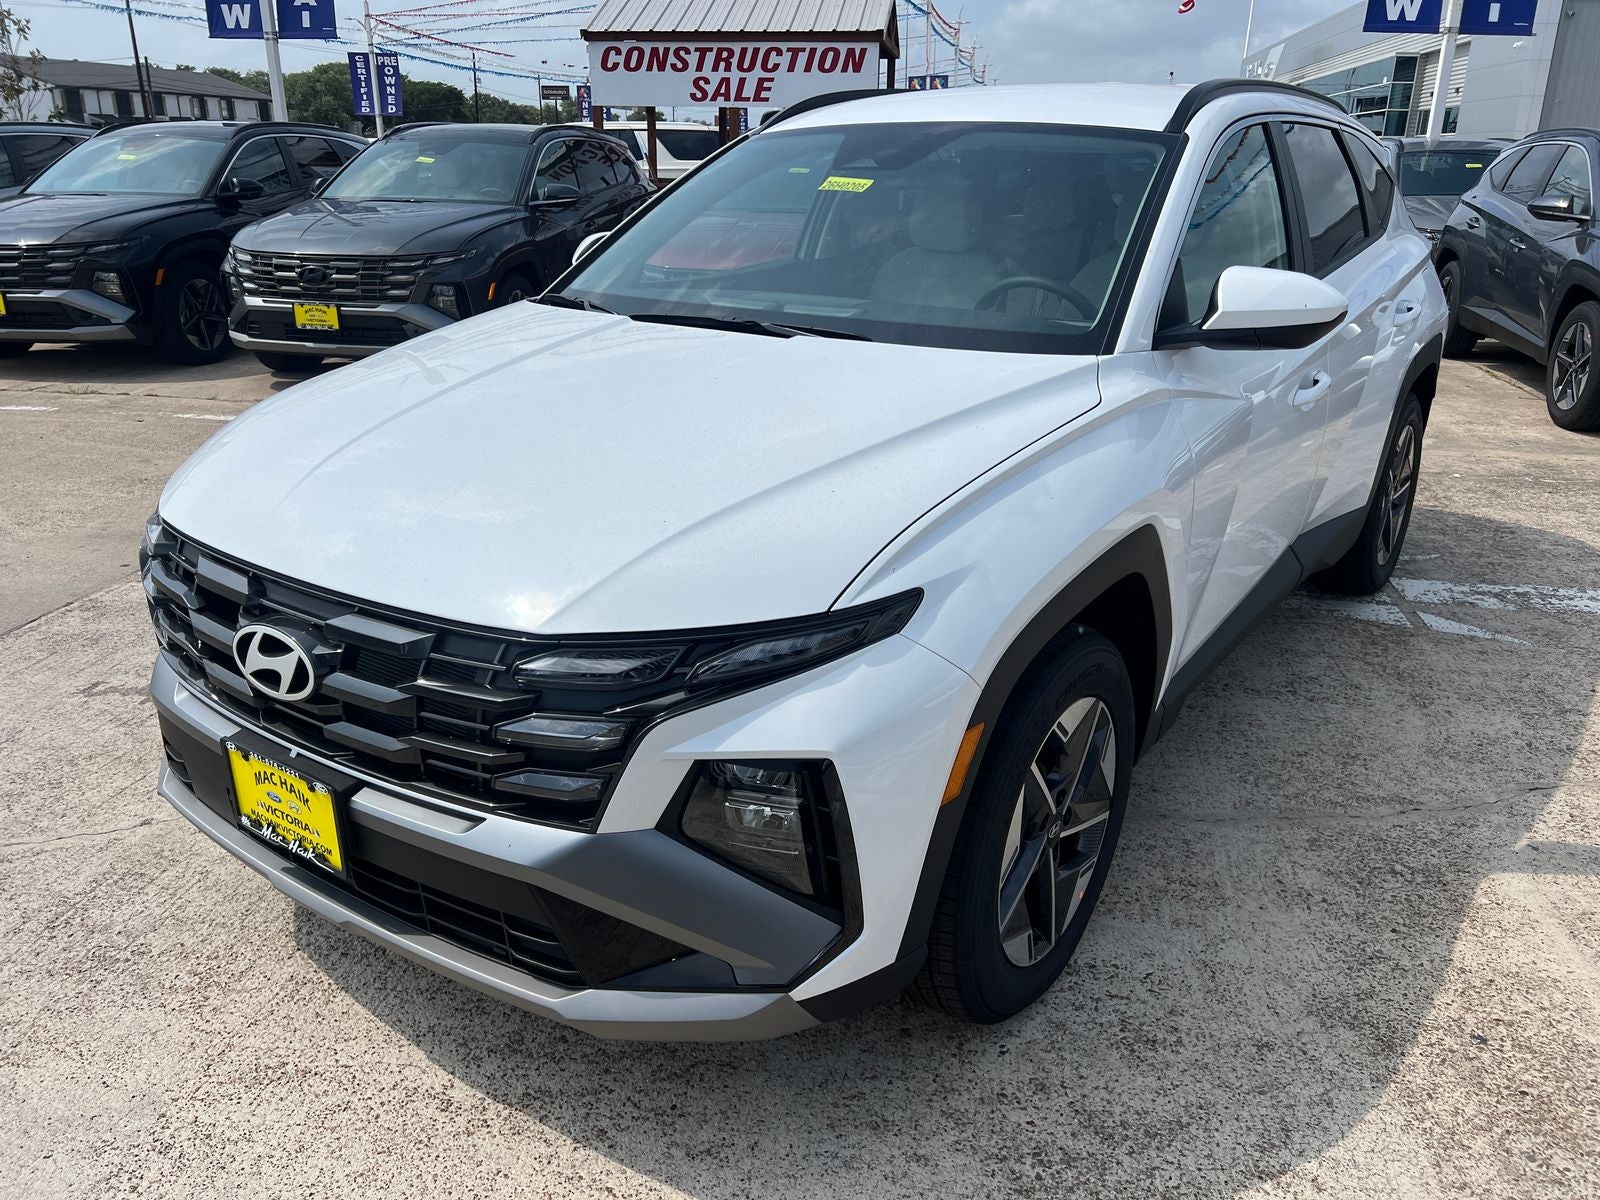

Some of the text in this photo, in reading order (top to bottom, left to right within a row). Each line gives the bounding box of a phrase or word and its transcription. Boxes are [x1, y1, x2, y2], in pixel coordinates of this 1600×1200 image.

[377, 56, 398, 66] PRE
[600, 46, 867, 73] CONSTRUCTION
[355, 55, 370, 113] CERTIFIED
[384, 66, 397, 113] OWNED
[690, 76, 774, 103] SALE
[254, 770, 278, 786] MAC
[278, 775, 312, 814] HAIK
[262, 801, 313, 835] VICTORIA
